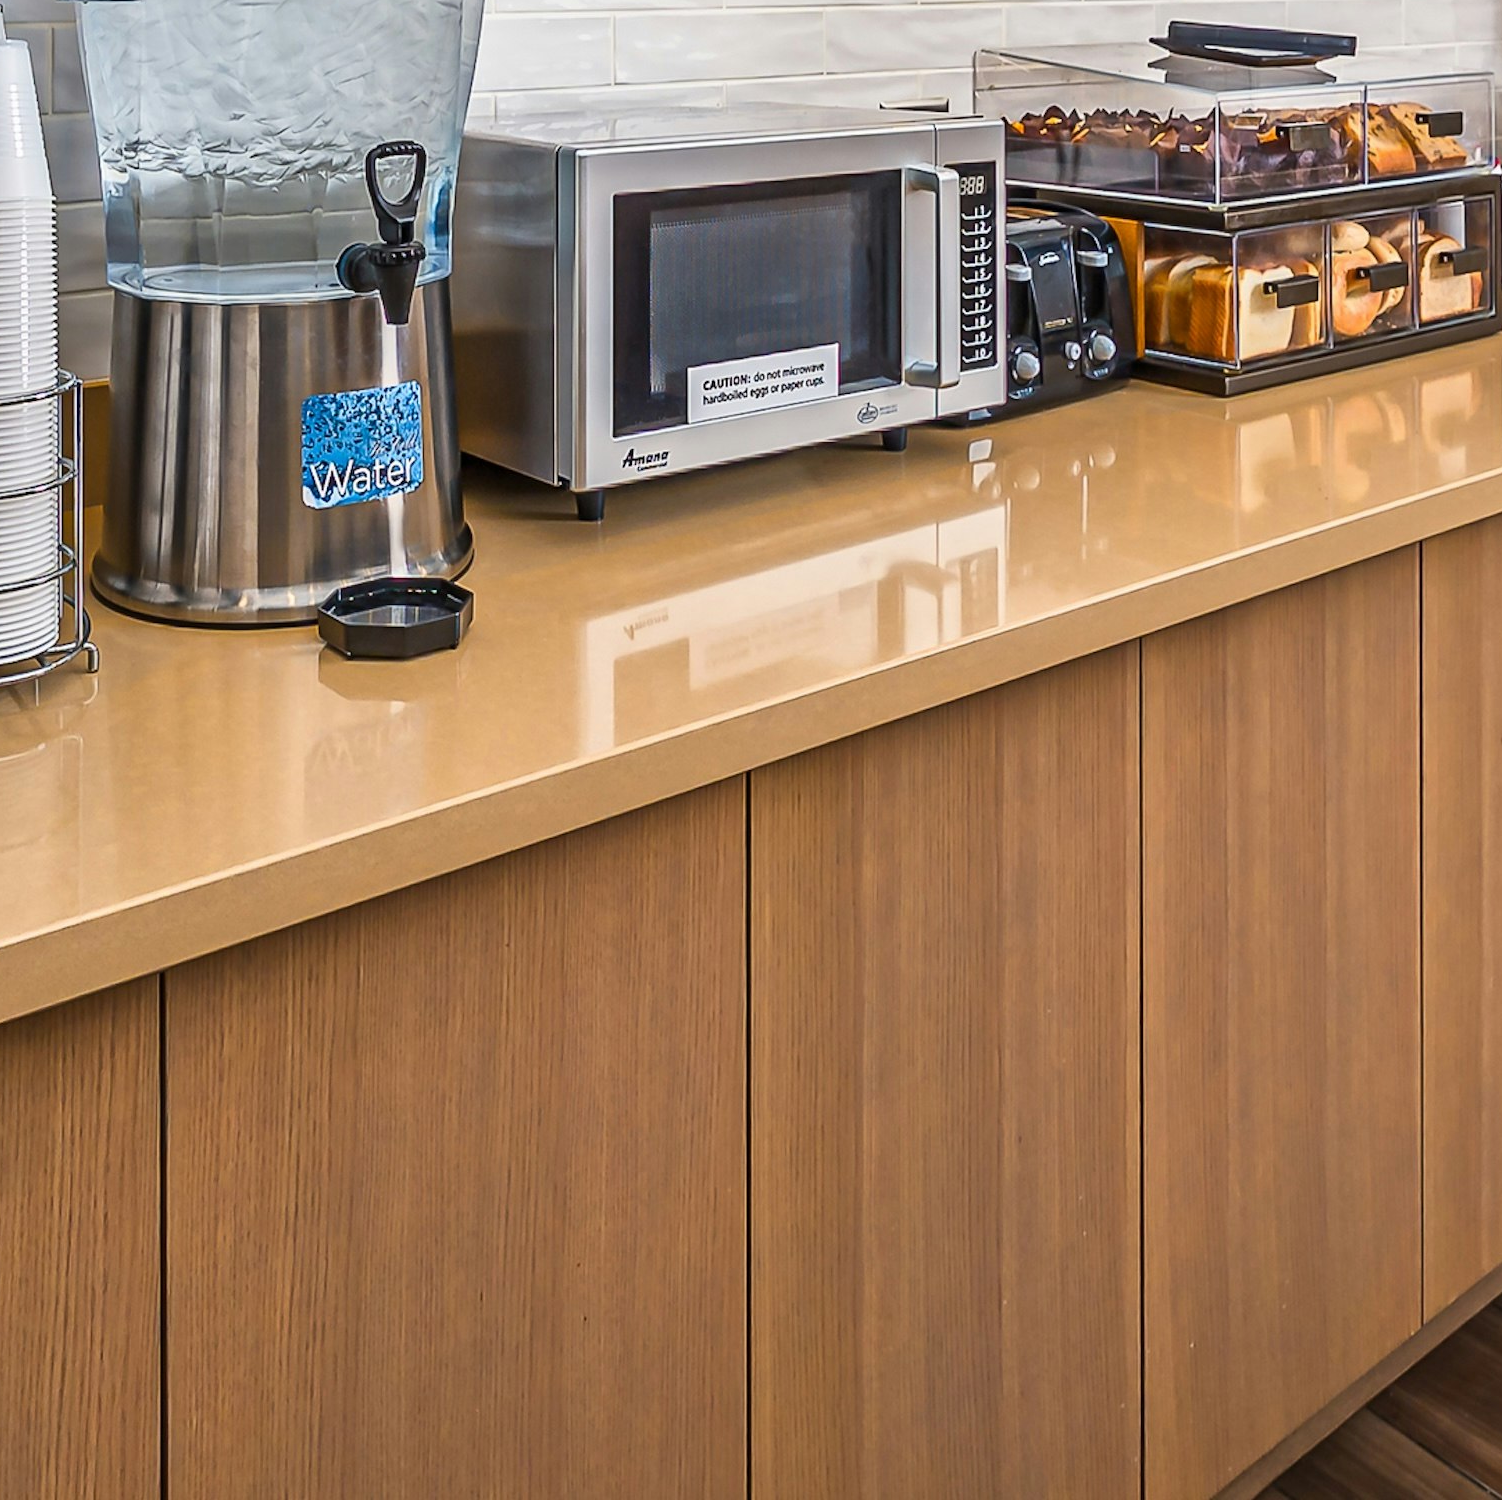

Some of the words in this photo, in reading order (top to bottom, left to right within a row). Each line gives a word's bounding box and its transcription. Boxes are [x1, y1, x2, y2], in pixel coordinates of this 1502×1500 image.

[703, 374, 751, 391] CAUTION:
[753, 372, 765, 383] do
[766, 369, 782, 379] not
[782, 363, 825, 377] microwave
[703, 387, 749, 406] hardboiled
[750, 385, 769, 399] eggs
[770, 384, 780, 394] or
[780, 381, 805, 394] paper
[805, 375, 825, 388] cups.
[622, 448, 669, 469] Amana
[310, 457, 416, 498] Water
